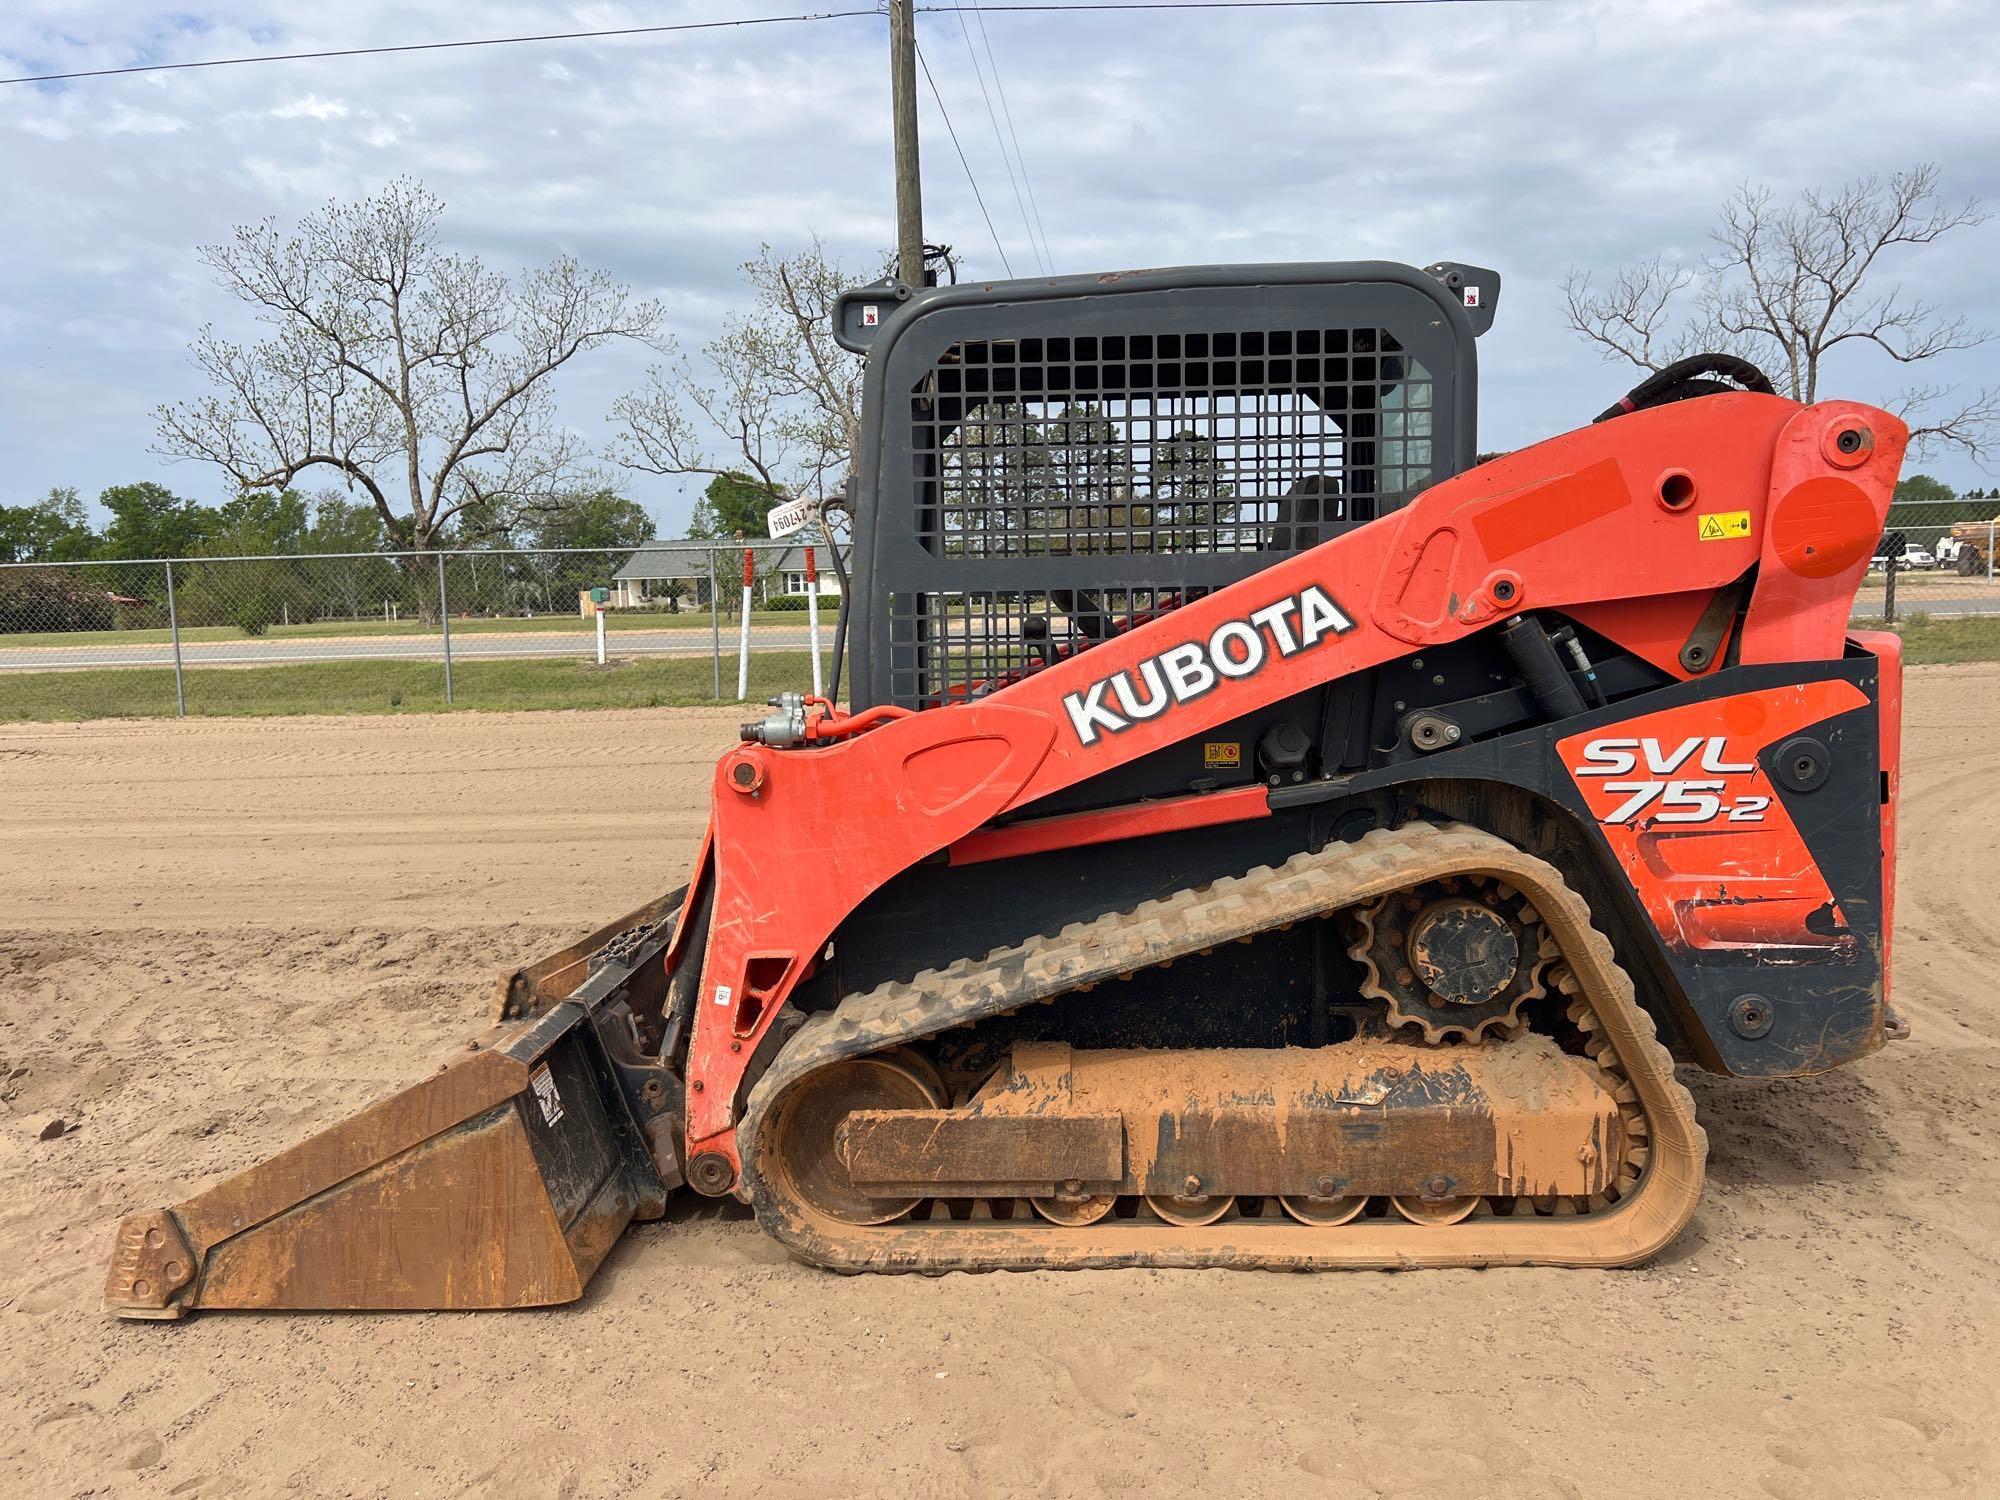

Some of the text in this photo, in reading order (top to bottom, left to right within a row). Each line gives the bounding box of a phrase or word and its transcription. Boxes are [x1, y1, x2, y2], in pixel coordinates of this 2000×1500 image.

[1062, 585, 1353, 746] KUBOTA
[1574, 736, 1755, 776] SVL
[1602, 779, 1771, 825] 75-2
